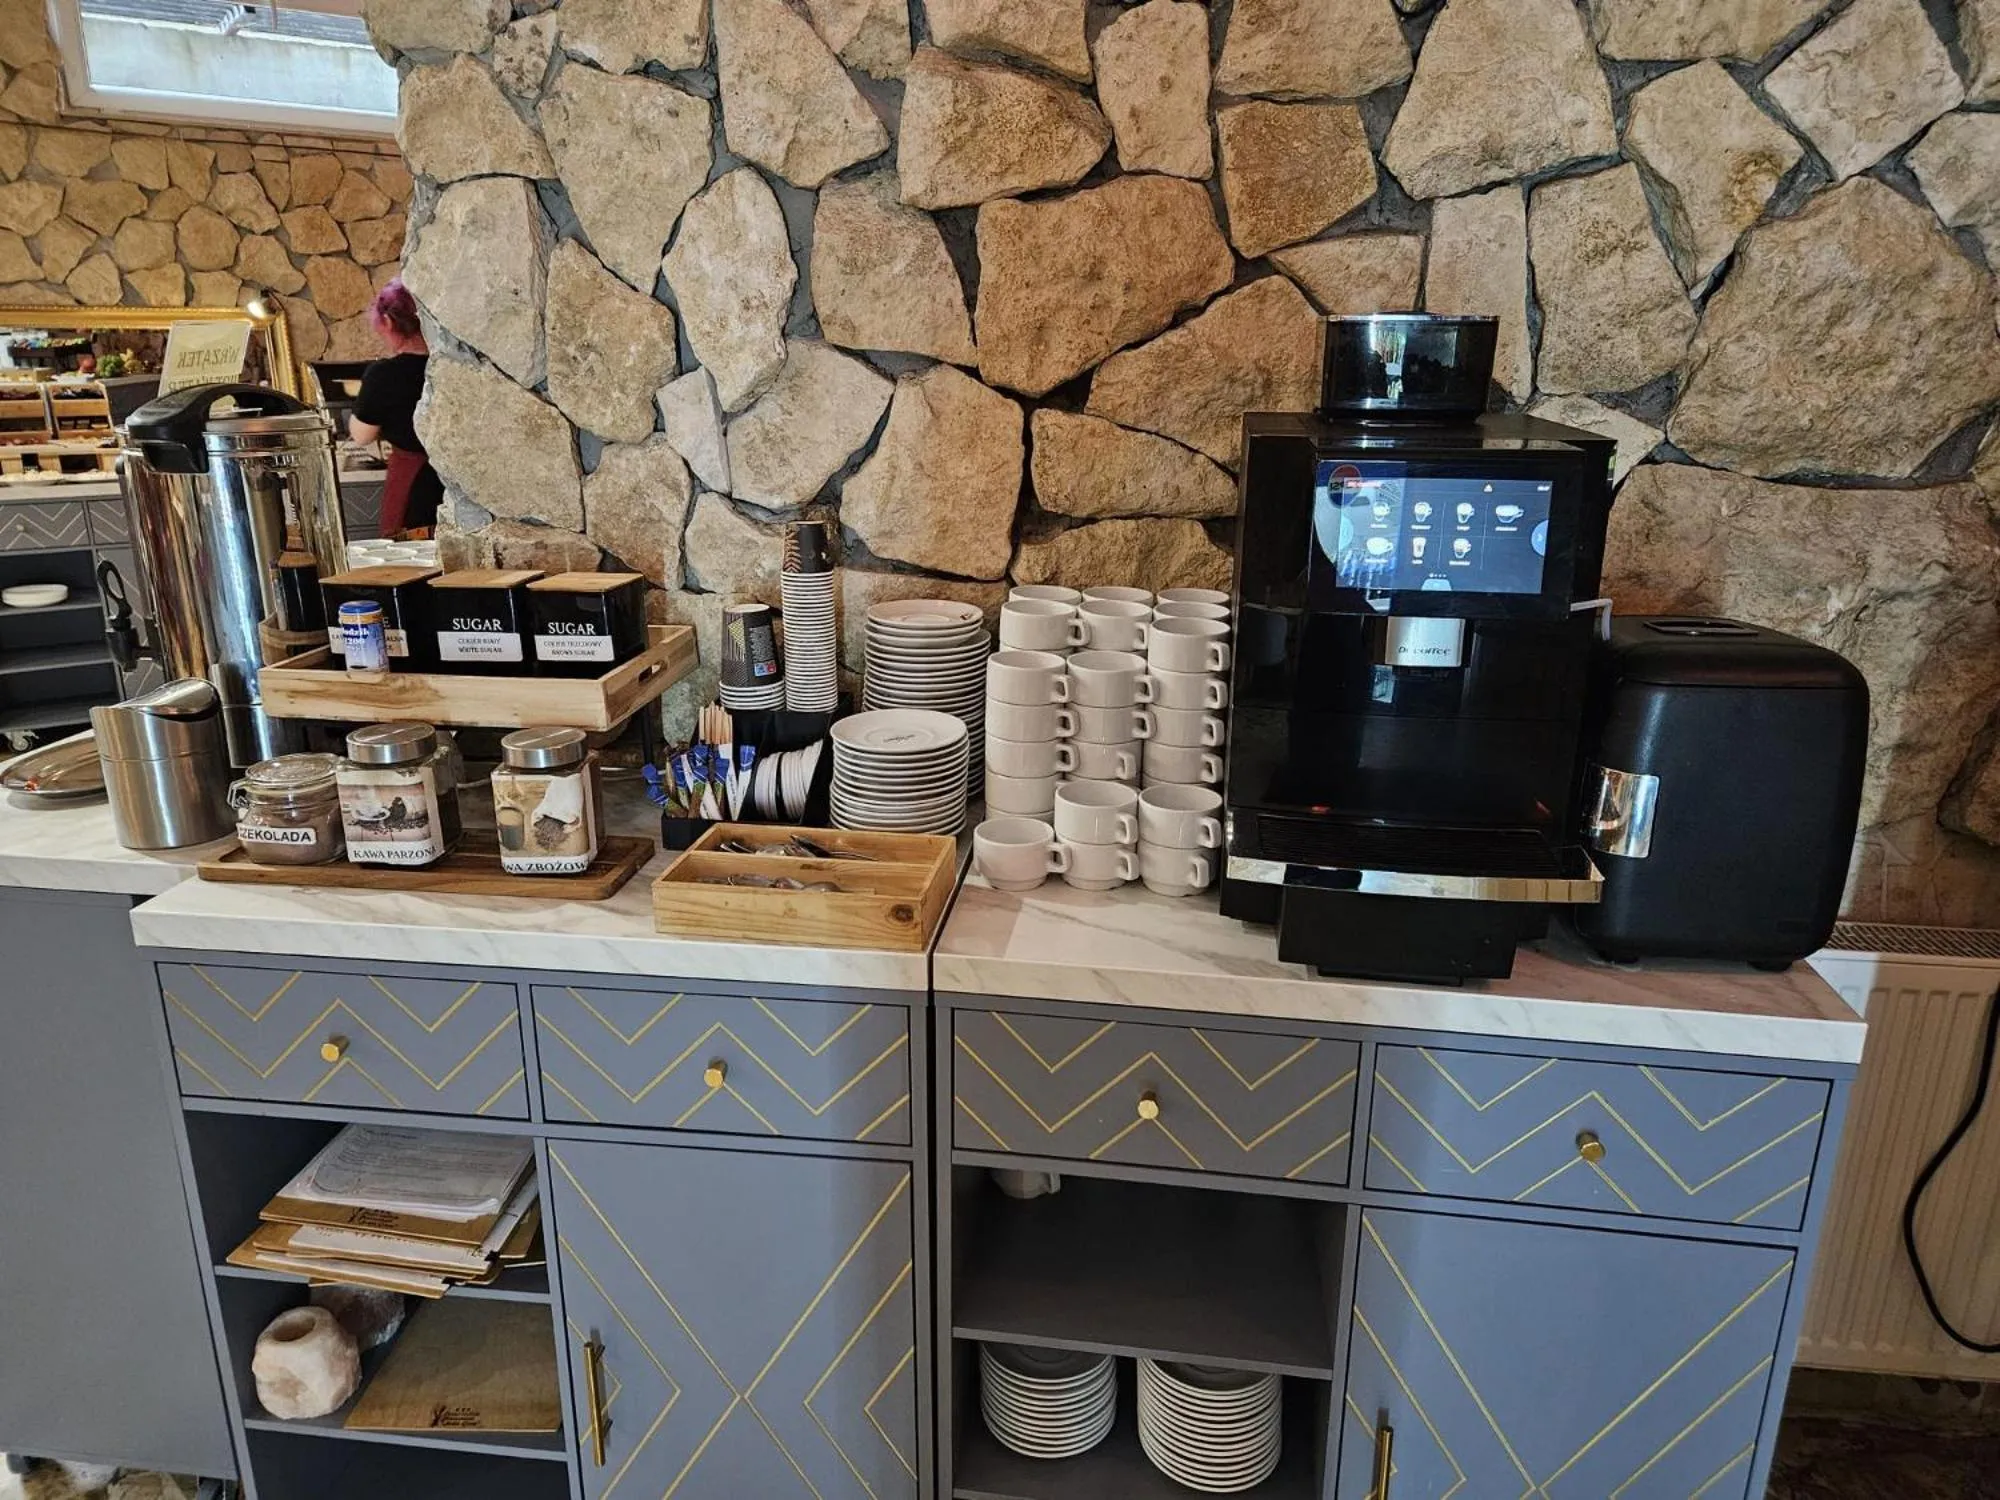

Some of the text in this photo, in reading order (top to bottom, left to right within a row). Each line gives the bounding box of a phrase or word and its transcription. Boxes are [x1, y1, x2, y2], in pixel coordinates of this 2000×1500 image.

[452, 618, 503, 631] SUGAR
[548, 622, 596, 635] SUGAR
[353, 850, 385, 859] KAWA
